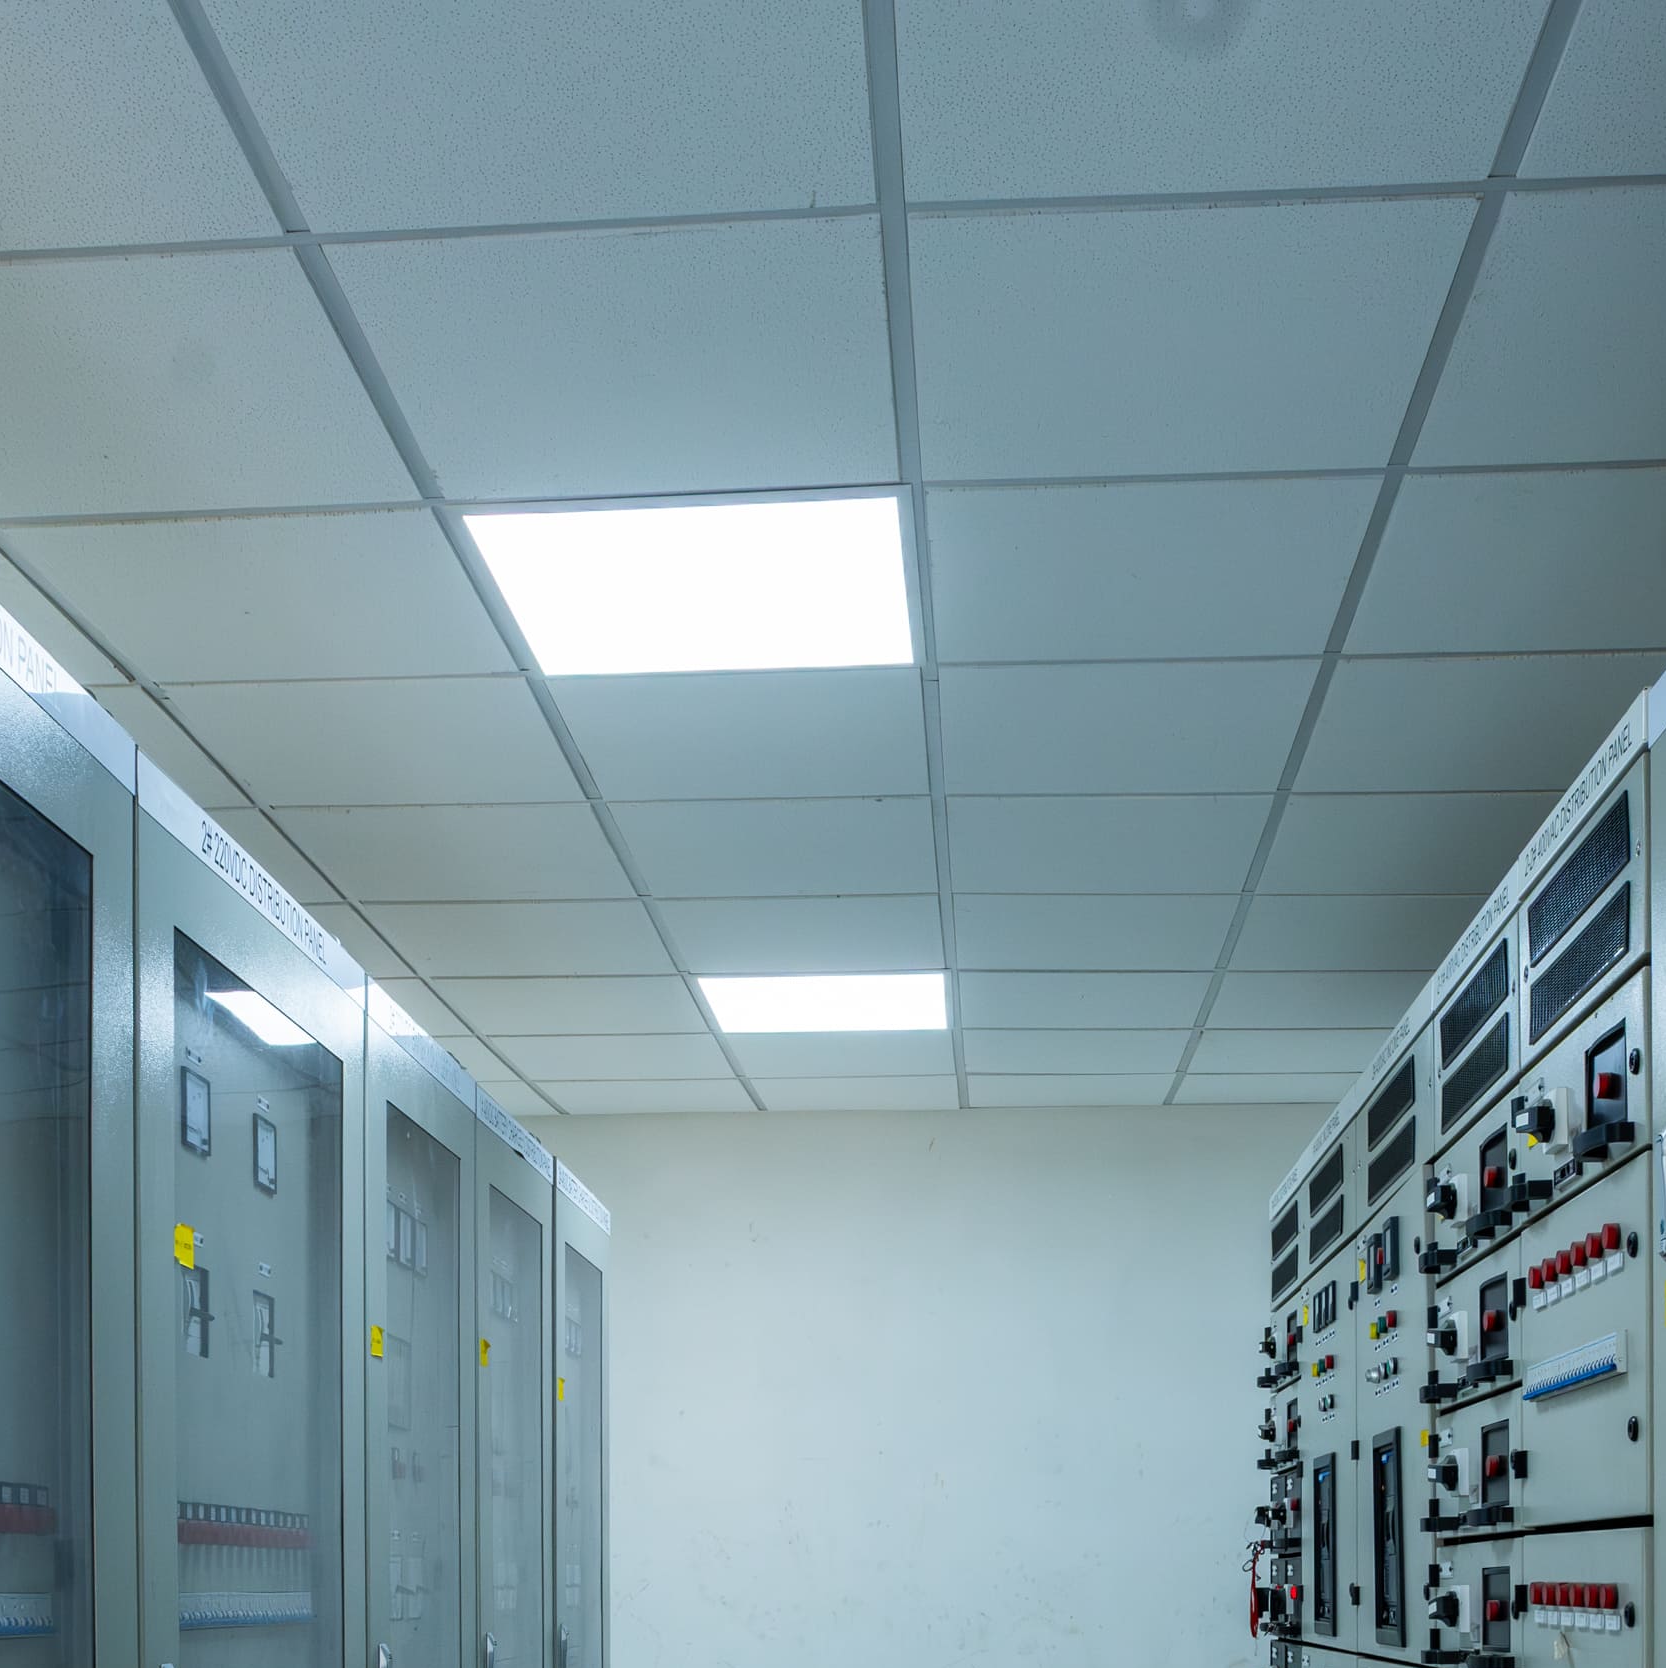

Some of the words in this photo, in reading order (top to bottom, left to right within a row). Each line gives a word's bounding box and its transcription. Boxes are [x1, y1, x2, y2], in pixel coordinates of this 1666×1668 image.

[17, 635, 62, 714] PANEL
[1560, 751, 1608, 833] DISTRIBUTION
[1608, 722, 1633, 771] PANEL
[214, 832, 248, 890] 220VDC
[249, 864, 304, 943] DISTRIBUTION
[304, 918, 327, 966] PANEL
